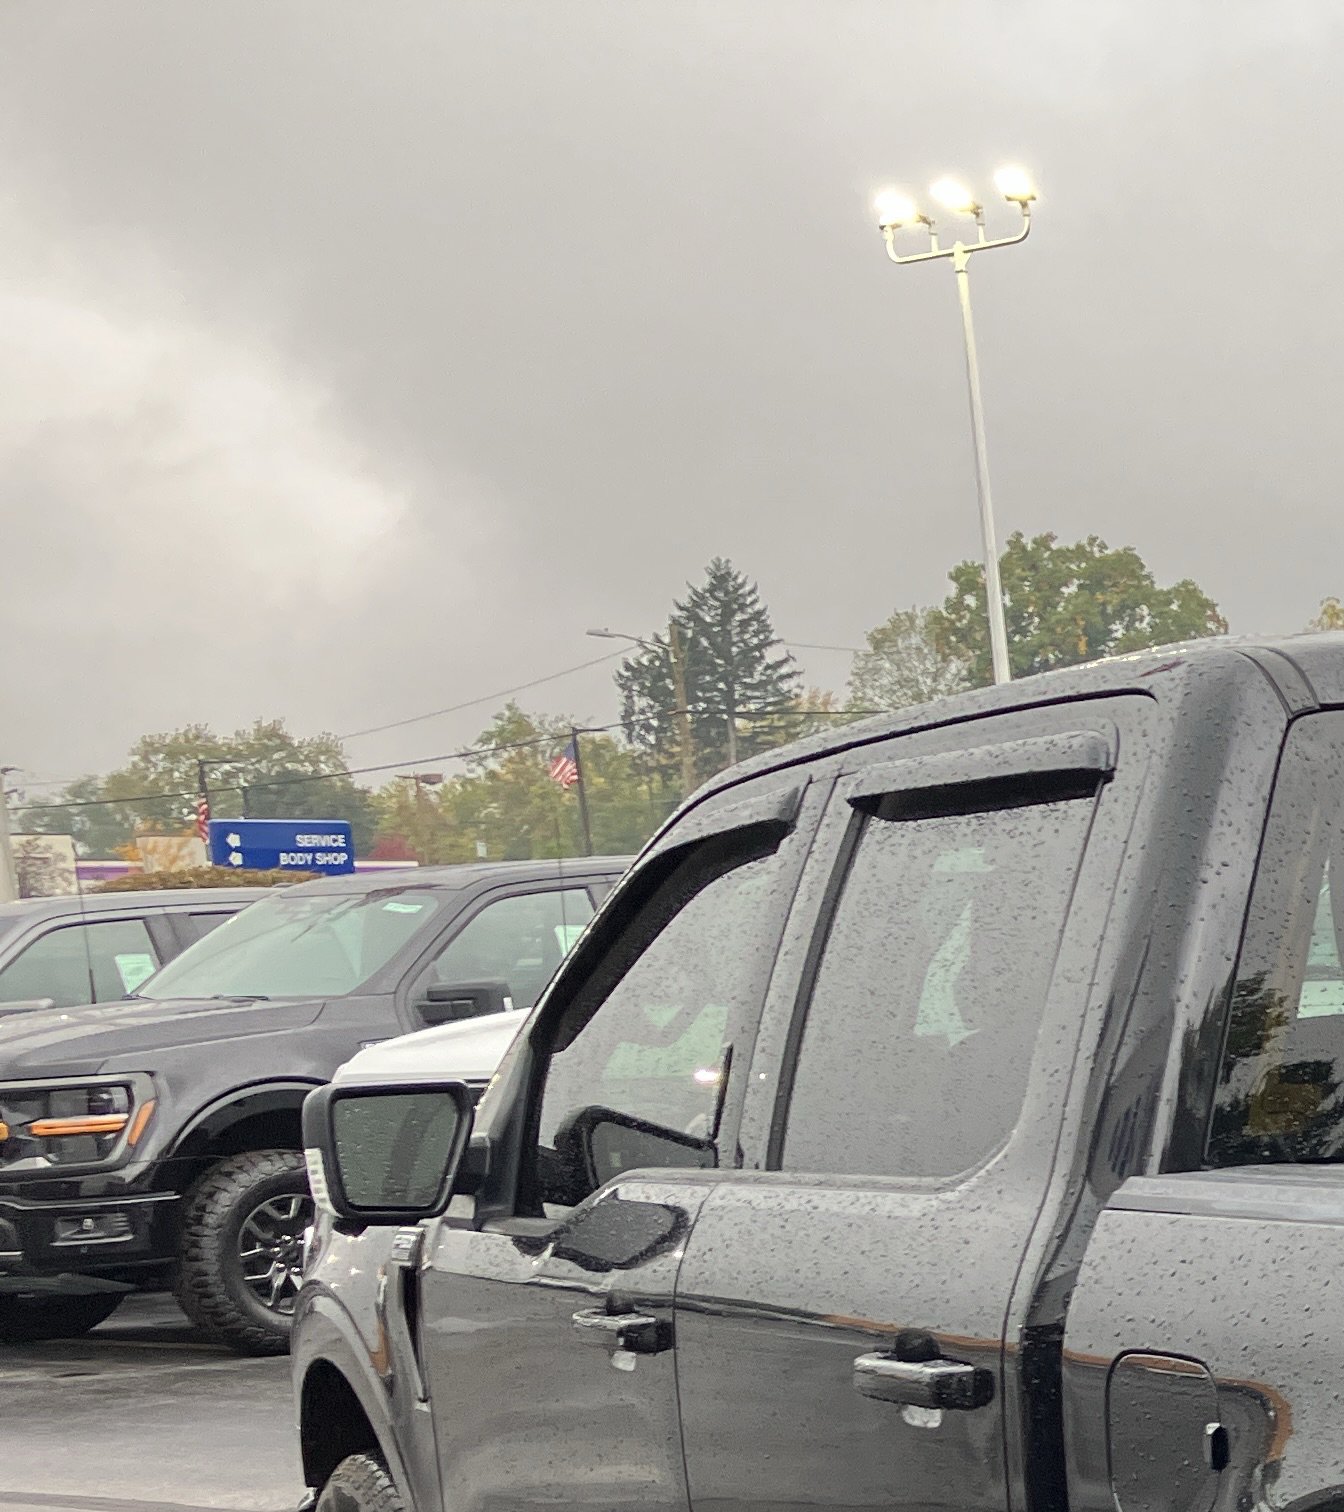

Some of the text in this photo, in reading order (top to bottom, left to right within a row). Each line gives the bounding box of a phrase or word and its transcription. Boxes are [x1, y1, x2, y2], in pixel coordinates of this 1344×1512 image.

[295, 834, 346, 847] SERVICE
[279, 852, 348, 865] BODY SHOP
